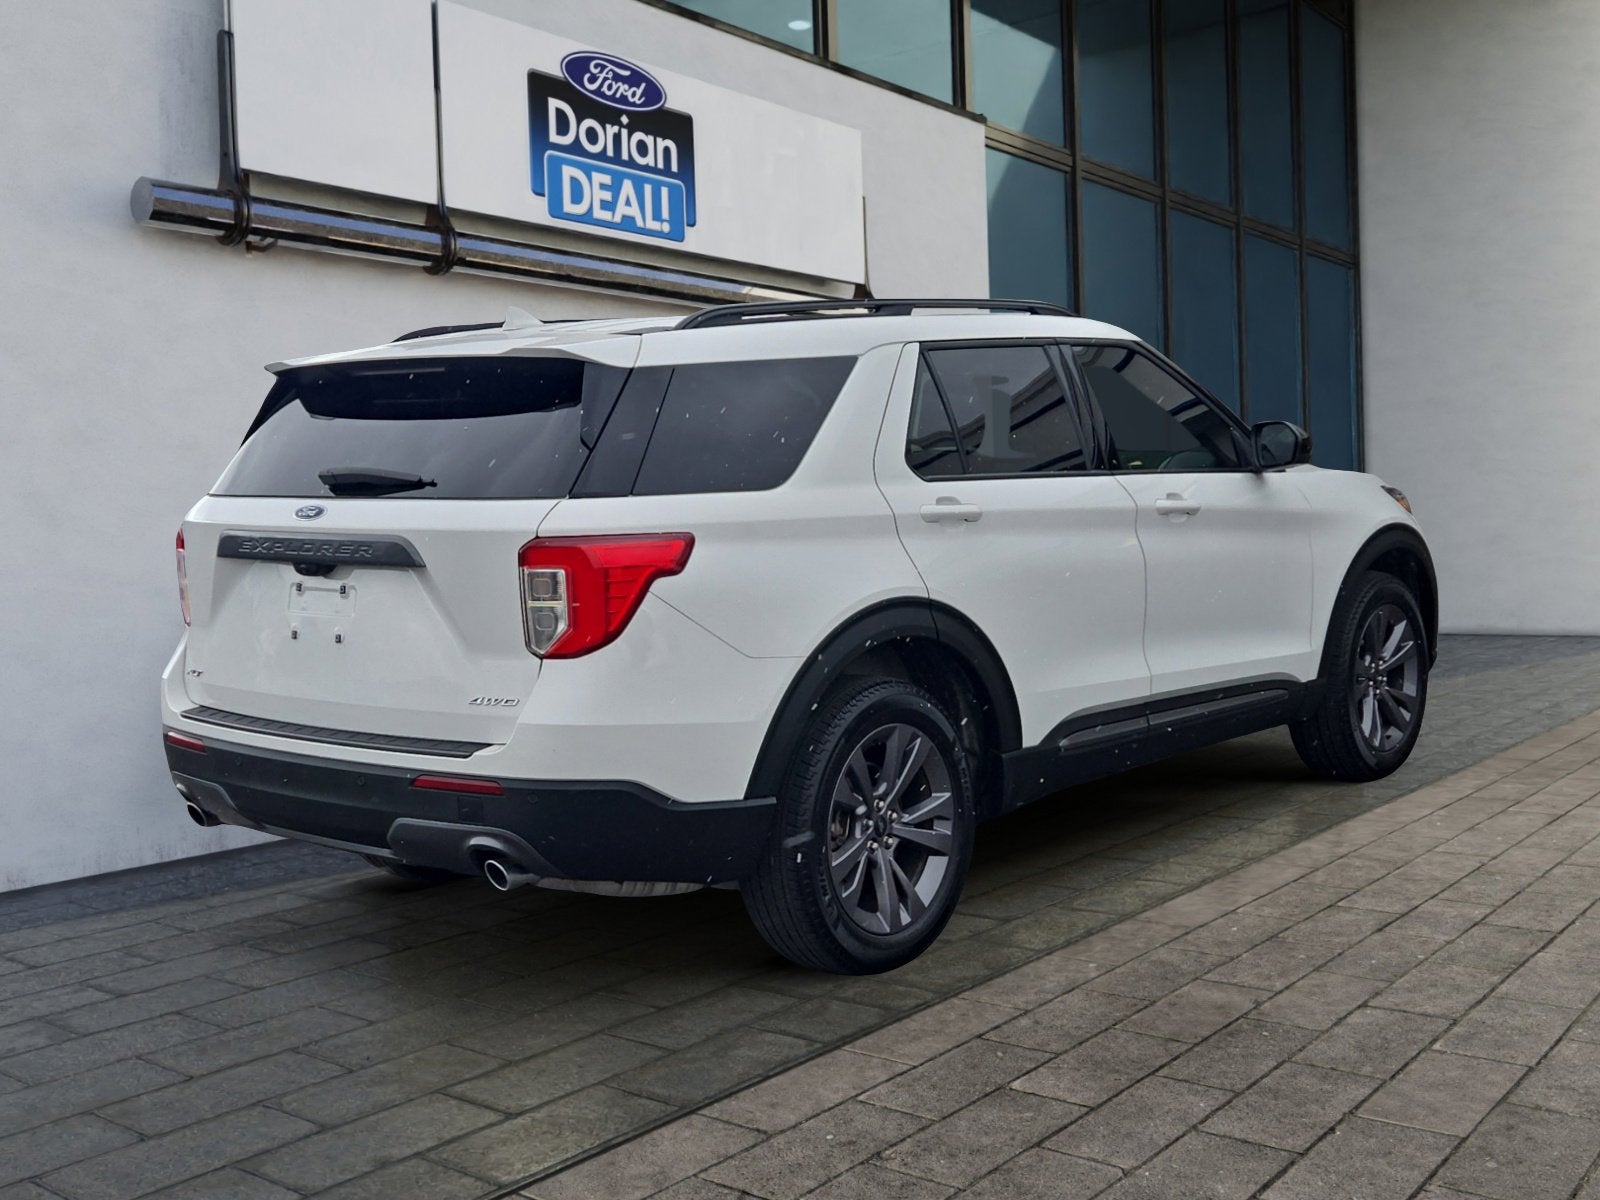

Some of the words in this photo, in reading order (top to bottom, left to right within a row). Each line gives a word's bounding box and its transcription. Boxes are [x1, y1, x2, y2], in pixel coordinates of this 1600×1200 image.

[583, 59, 646, 104] Ford
[548, 97, 679, 173] Dorian
[561, 164, 671, 234] DEAL!
[238, 541, 374, 558] EXPLORER
[468, 696, 520, 707] 4WD
